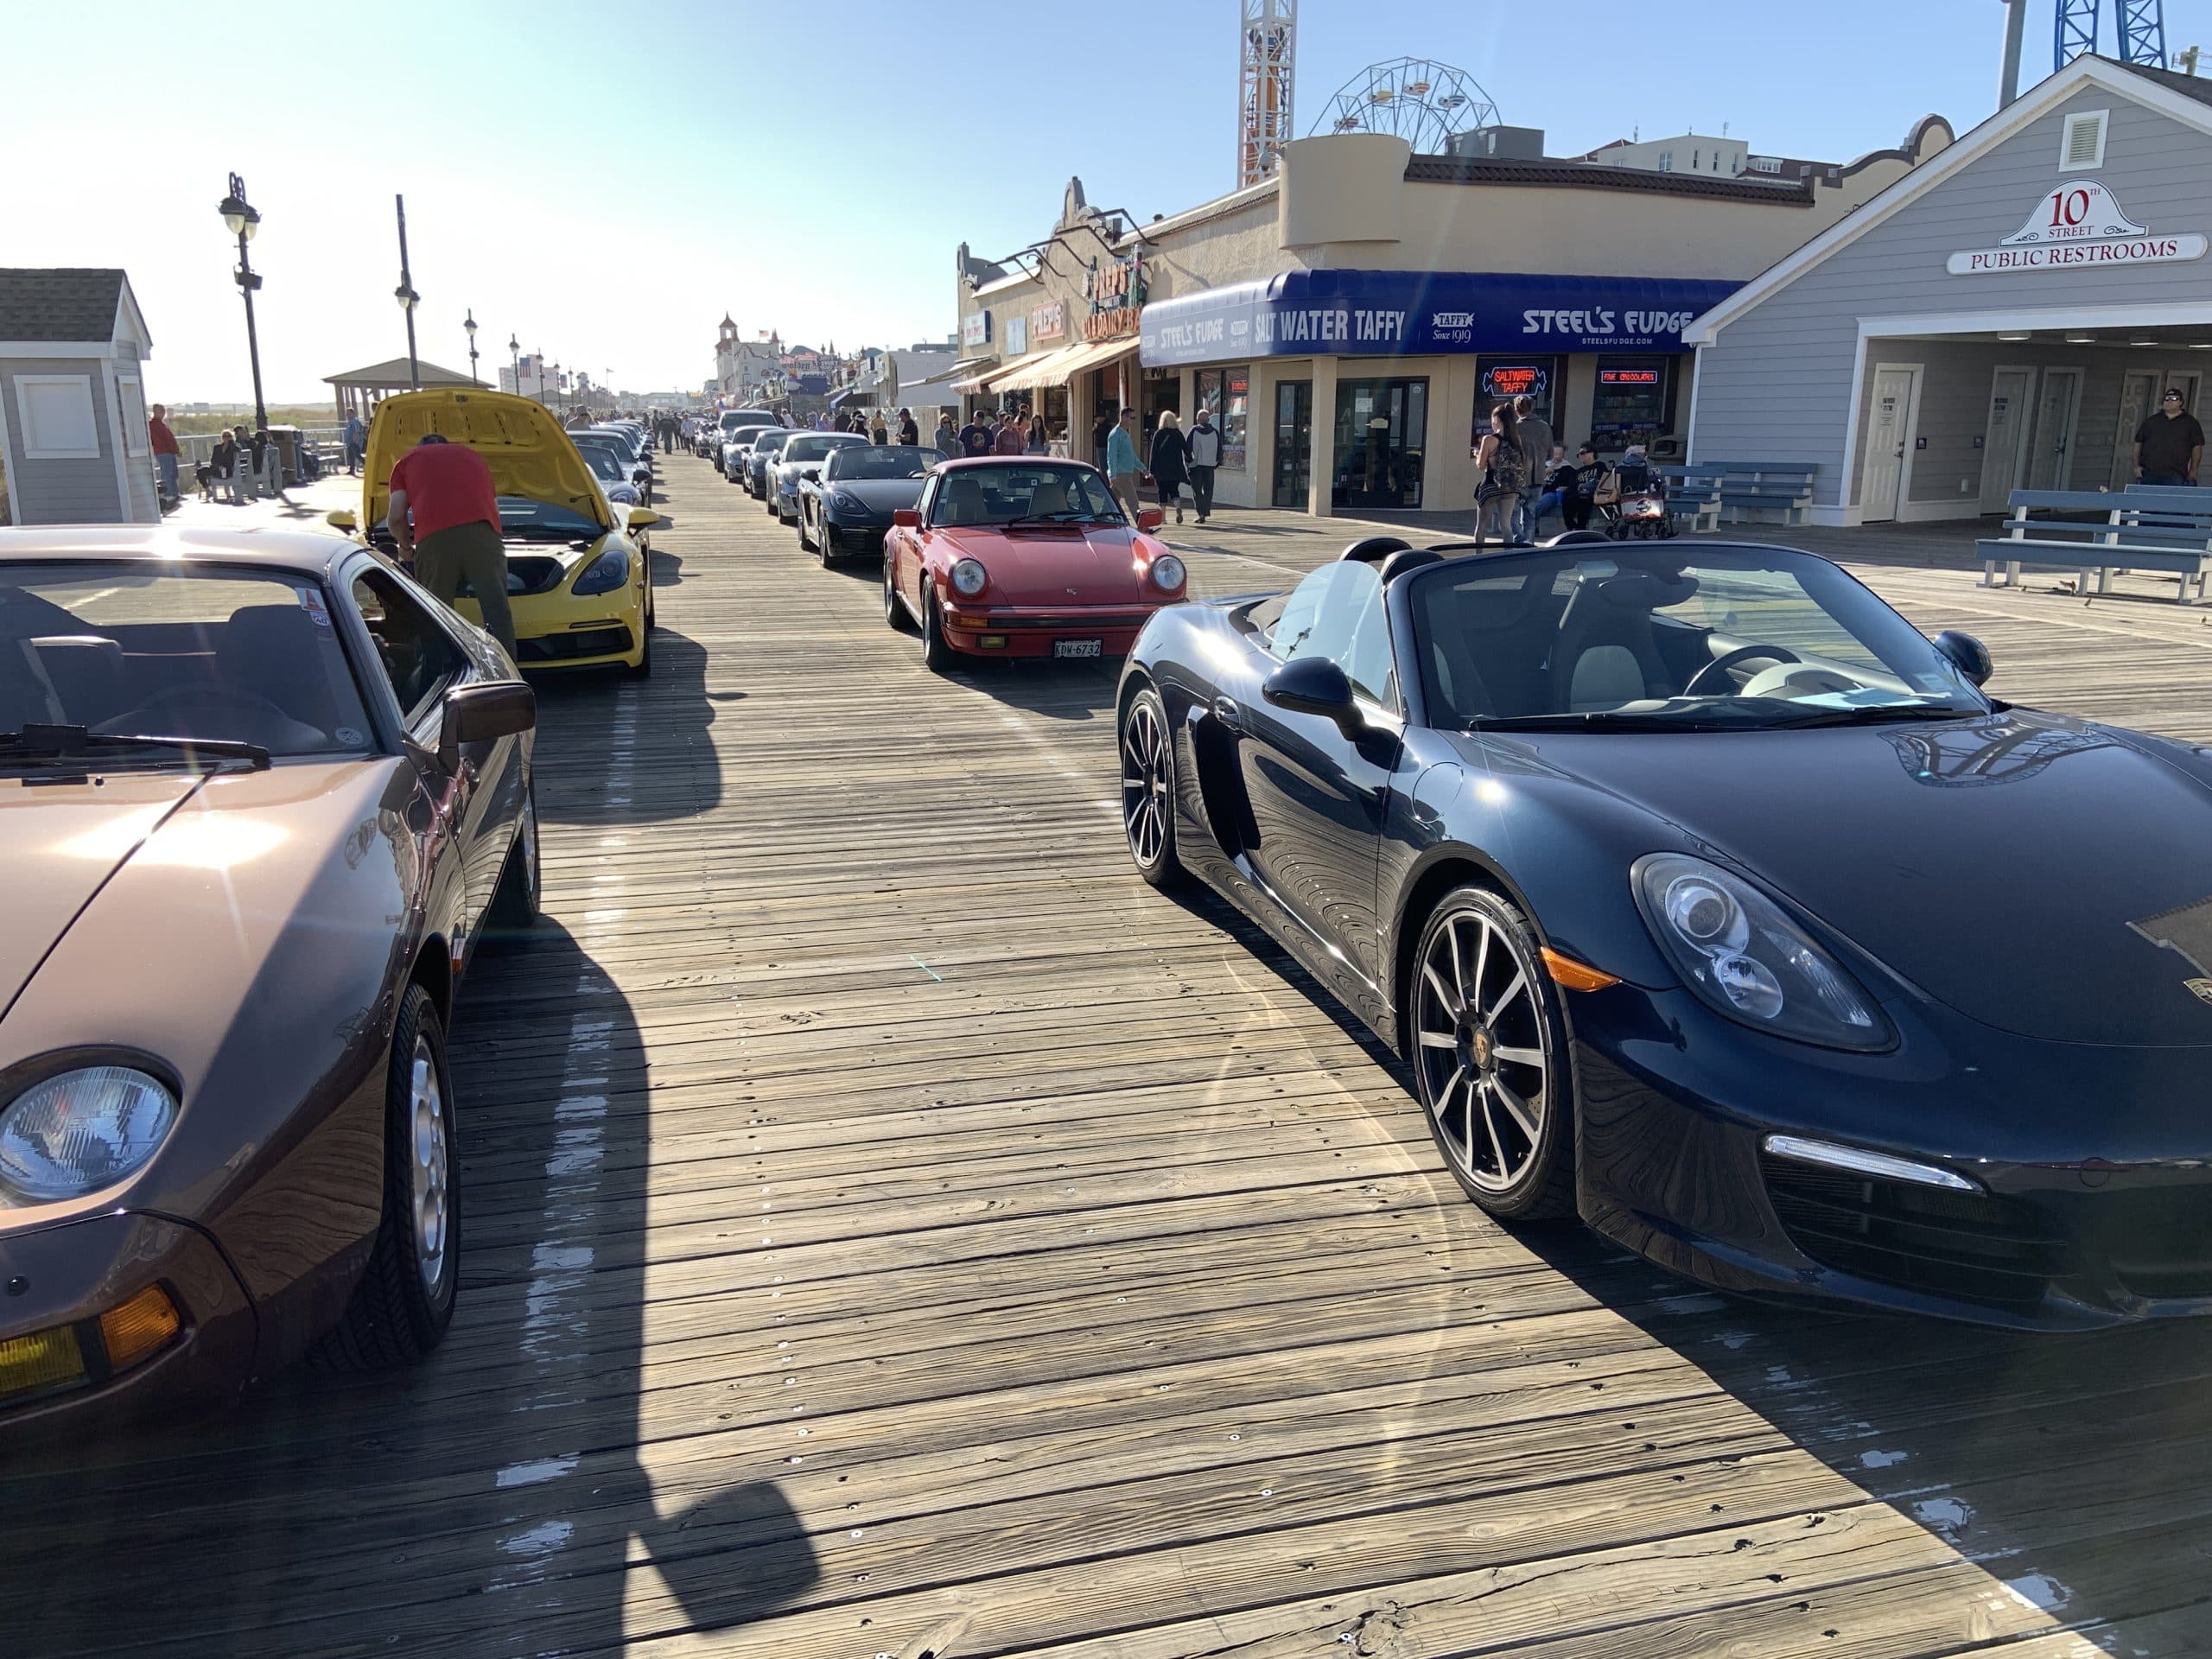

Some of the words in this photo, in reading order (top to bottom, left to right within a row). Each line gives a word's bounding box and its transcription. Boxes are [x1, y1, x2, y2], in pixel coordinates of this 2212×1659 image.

[2049, 226, 2094, 238] STREET
[1971, 250, 2043, 270] PUBLIC
[2048, 240, 2178, 264] RESTROOMS
[1097, 306, 1124, 335] DAIRY
[1126, 305, 1141, 333] BA
[1255, 312, 1276, 343] SALT
[1280, 310, 1349, 341] WATER
[1355, 310, 1406, 340] TAFFY
[1439, 315, 1468, 326] TAFFY
[1522, 306, 1615, 334] STEEL'S
[1624, 311, 1694, 334] FUDGE
[1160, 320, 1193, 348] STEEL'S
[1195, 317, 1224, 344] FUDGE
[1433, 329, 1451, 340] Since
[1452, 329, 1471, 344] 1919
[1494, 370, 1535, 382] SALTWATER
[1501, 382, 1529, 394] TAFFY
